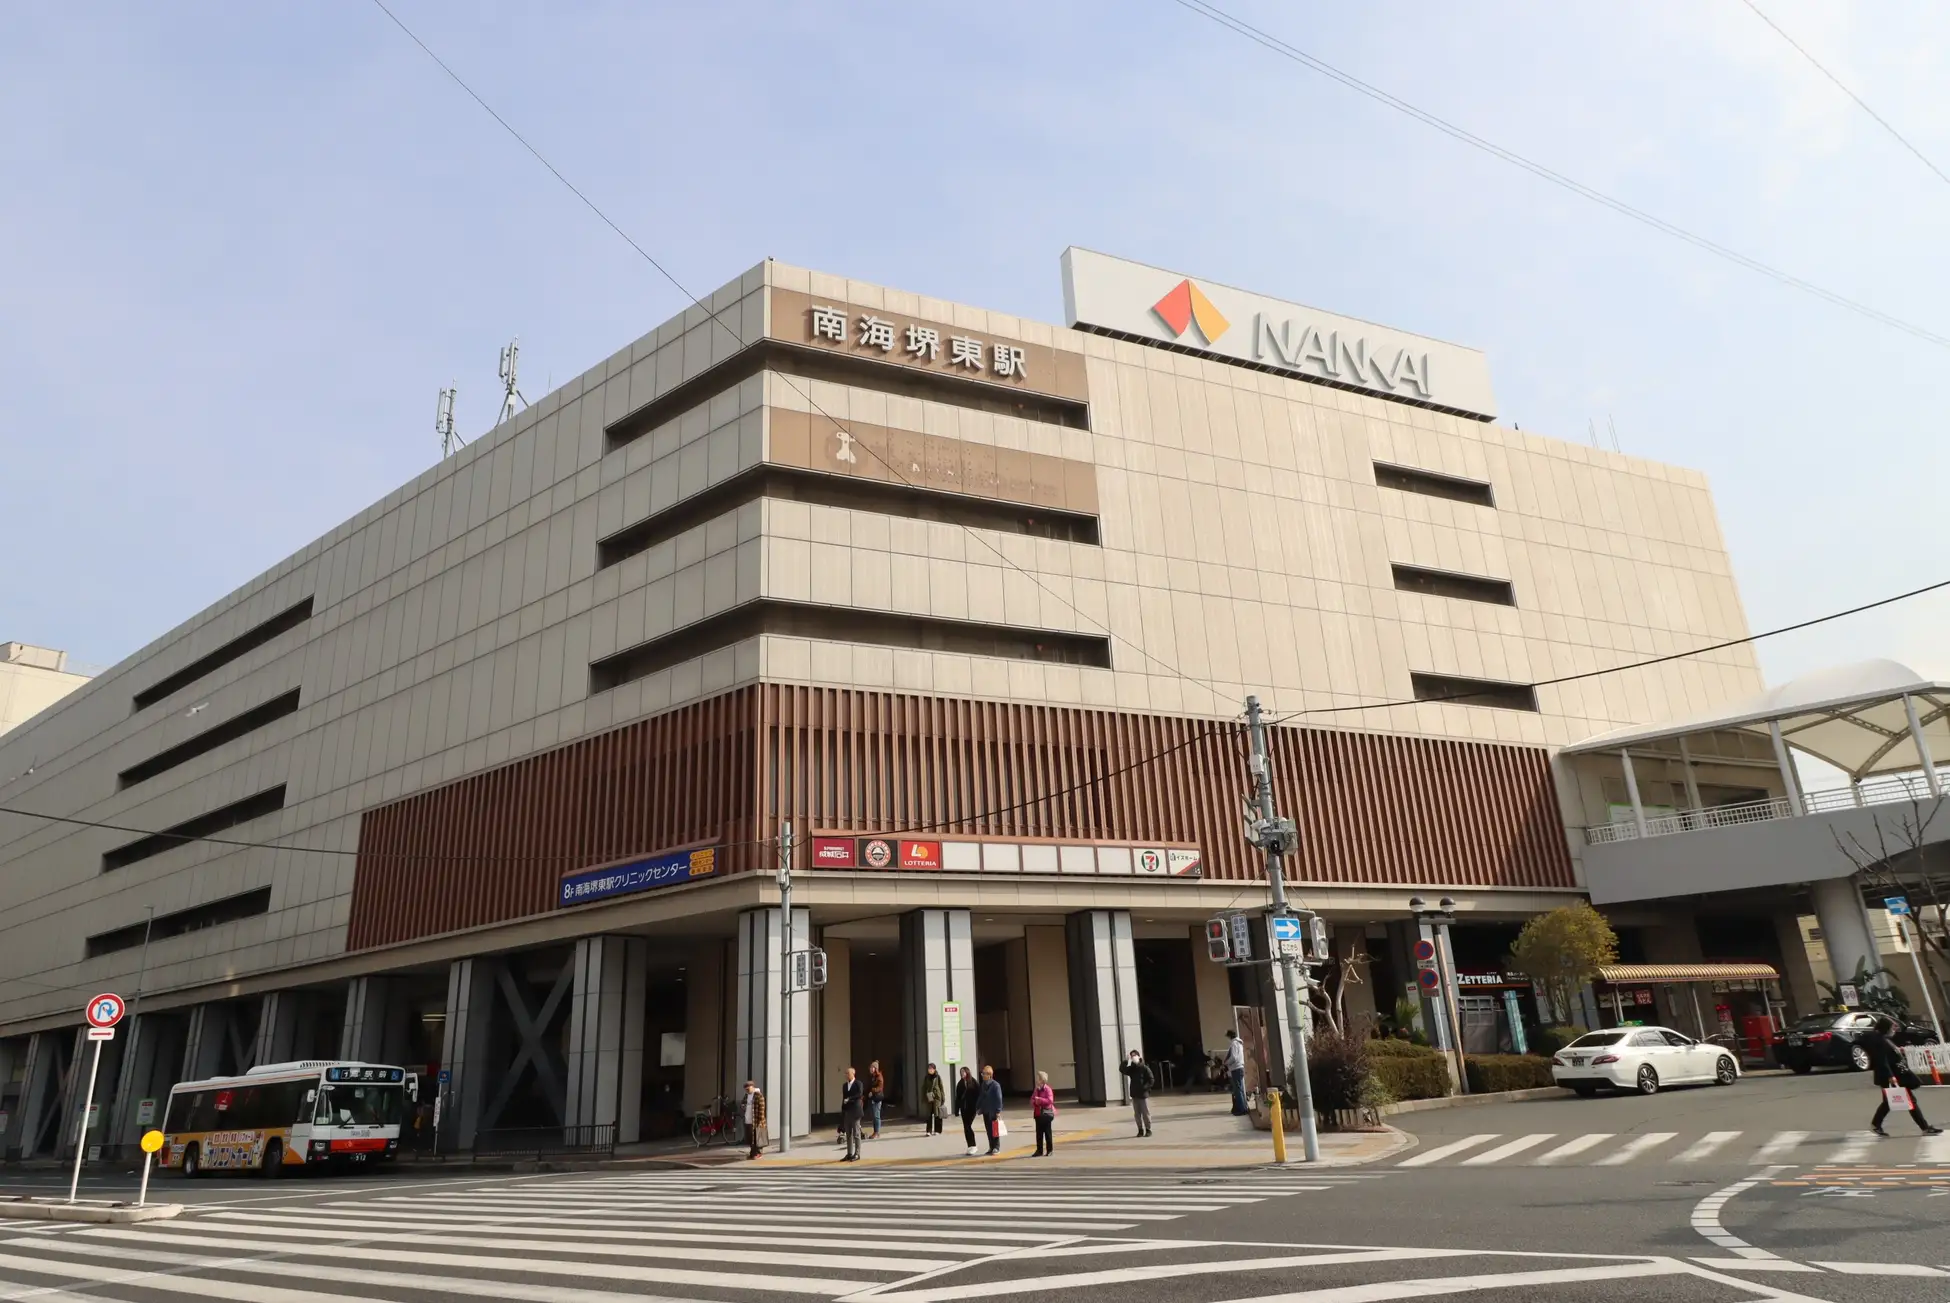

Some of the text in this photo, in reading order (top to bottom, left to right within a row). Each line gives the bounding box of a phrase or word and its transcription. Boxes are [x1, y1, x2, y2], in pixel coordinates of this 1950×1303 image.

[811, 305, 1028, 379] 南海堺東駅
[1256, 311, 1432, 399] NANKAI
[563, 863, 687, 899] 8F 南海堺東駅クリニックセンター
[1457, 973, 1503, 985] ZETTERIA
